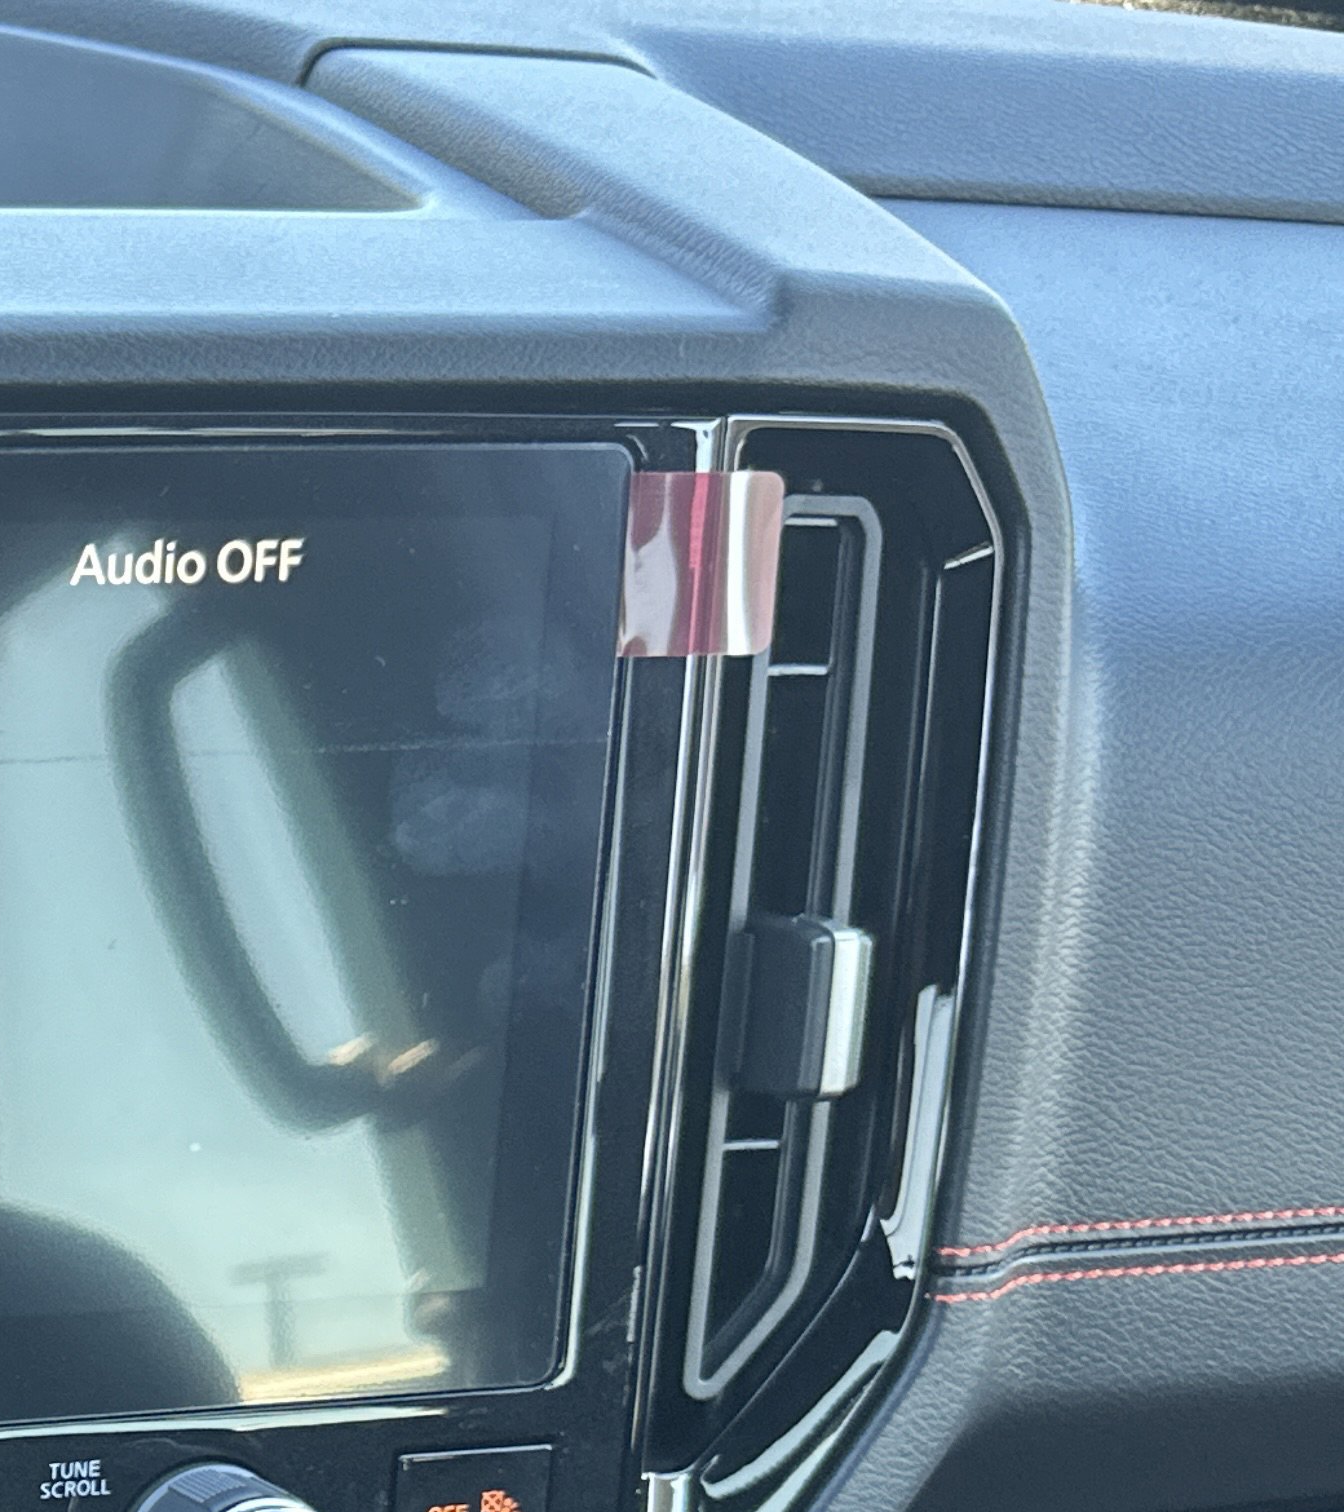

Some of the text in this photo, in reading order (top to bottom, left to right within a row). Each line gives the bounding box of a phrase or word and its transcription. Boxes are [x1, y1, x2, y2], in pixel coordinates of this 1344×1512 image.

[69, 538, 305, 587] Audio OFF
[48, 1460, 101, 1481] TUNE
[40, 1478, 111, 1500] SCROLL
